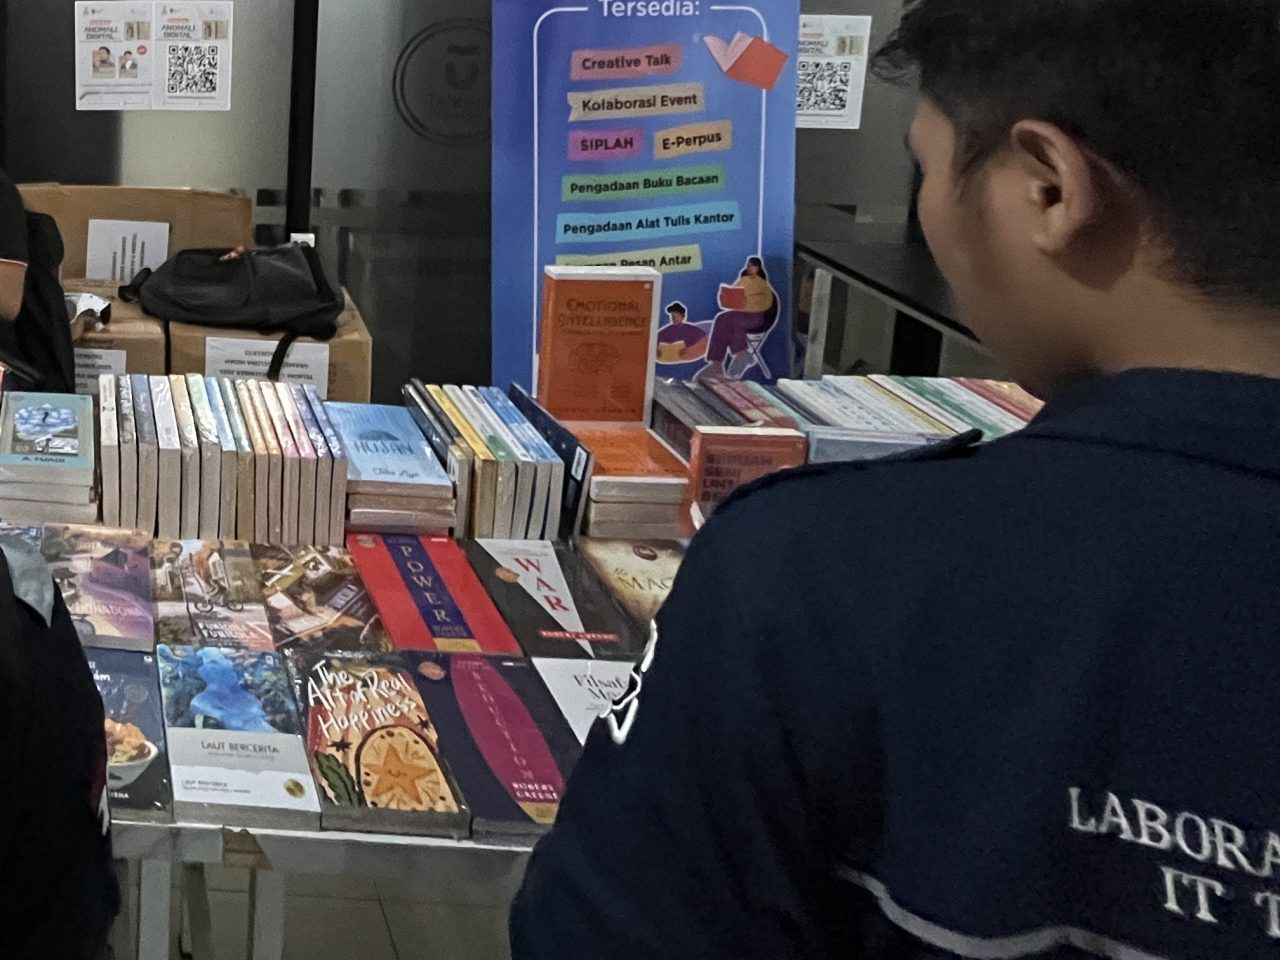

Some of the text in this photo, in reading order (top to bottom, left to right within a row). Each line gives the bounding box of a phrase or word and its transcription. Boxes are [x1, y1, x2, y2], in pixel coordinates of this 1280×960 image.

[582, 53, 672, 71] Creative Talk
[582, 93, 698, 112] Kolaborasi Event
[580, 131, 723, 152] SIPLAH E-Perpus
[570, 172, 719, 194] Pengadaan Buku Bacaan
[563, 211, 735, 236] Pengadaan Alat Tulis Kantor
[659, 255, 692, 266] Antar
[400, 546, 452, 623] POWER
[514, 557, 570, 612] WAR
[311, 660, 354, 686] The
[308, 677, 347, 711] Art
[361, 670, 412, 699] Real
[317, 698, 417, 741] Happiness
[201, 741, 280, 754] LAUT BERCERITA
[1159, 865, 1226, 924] IT
